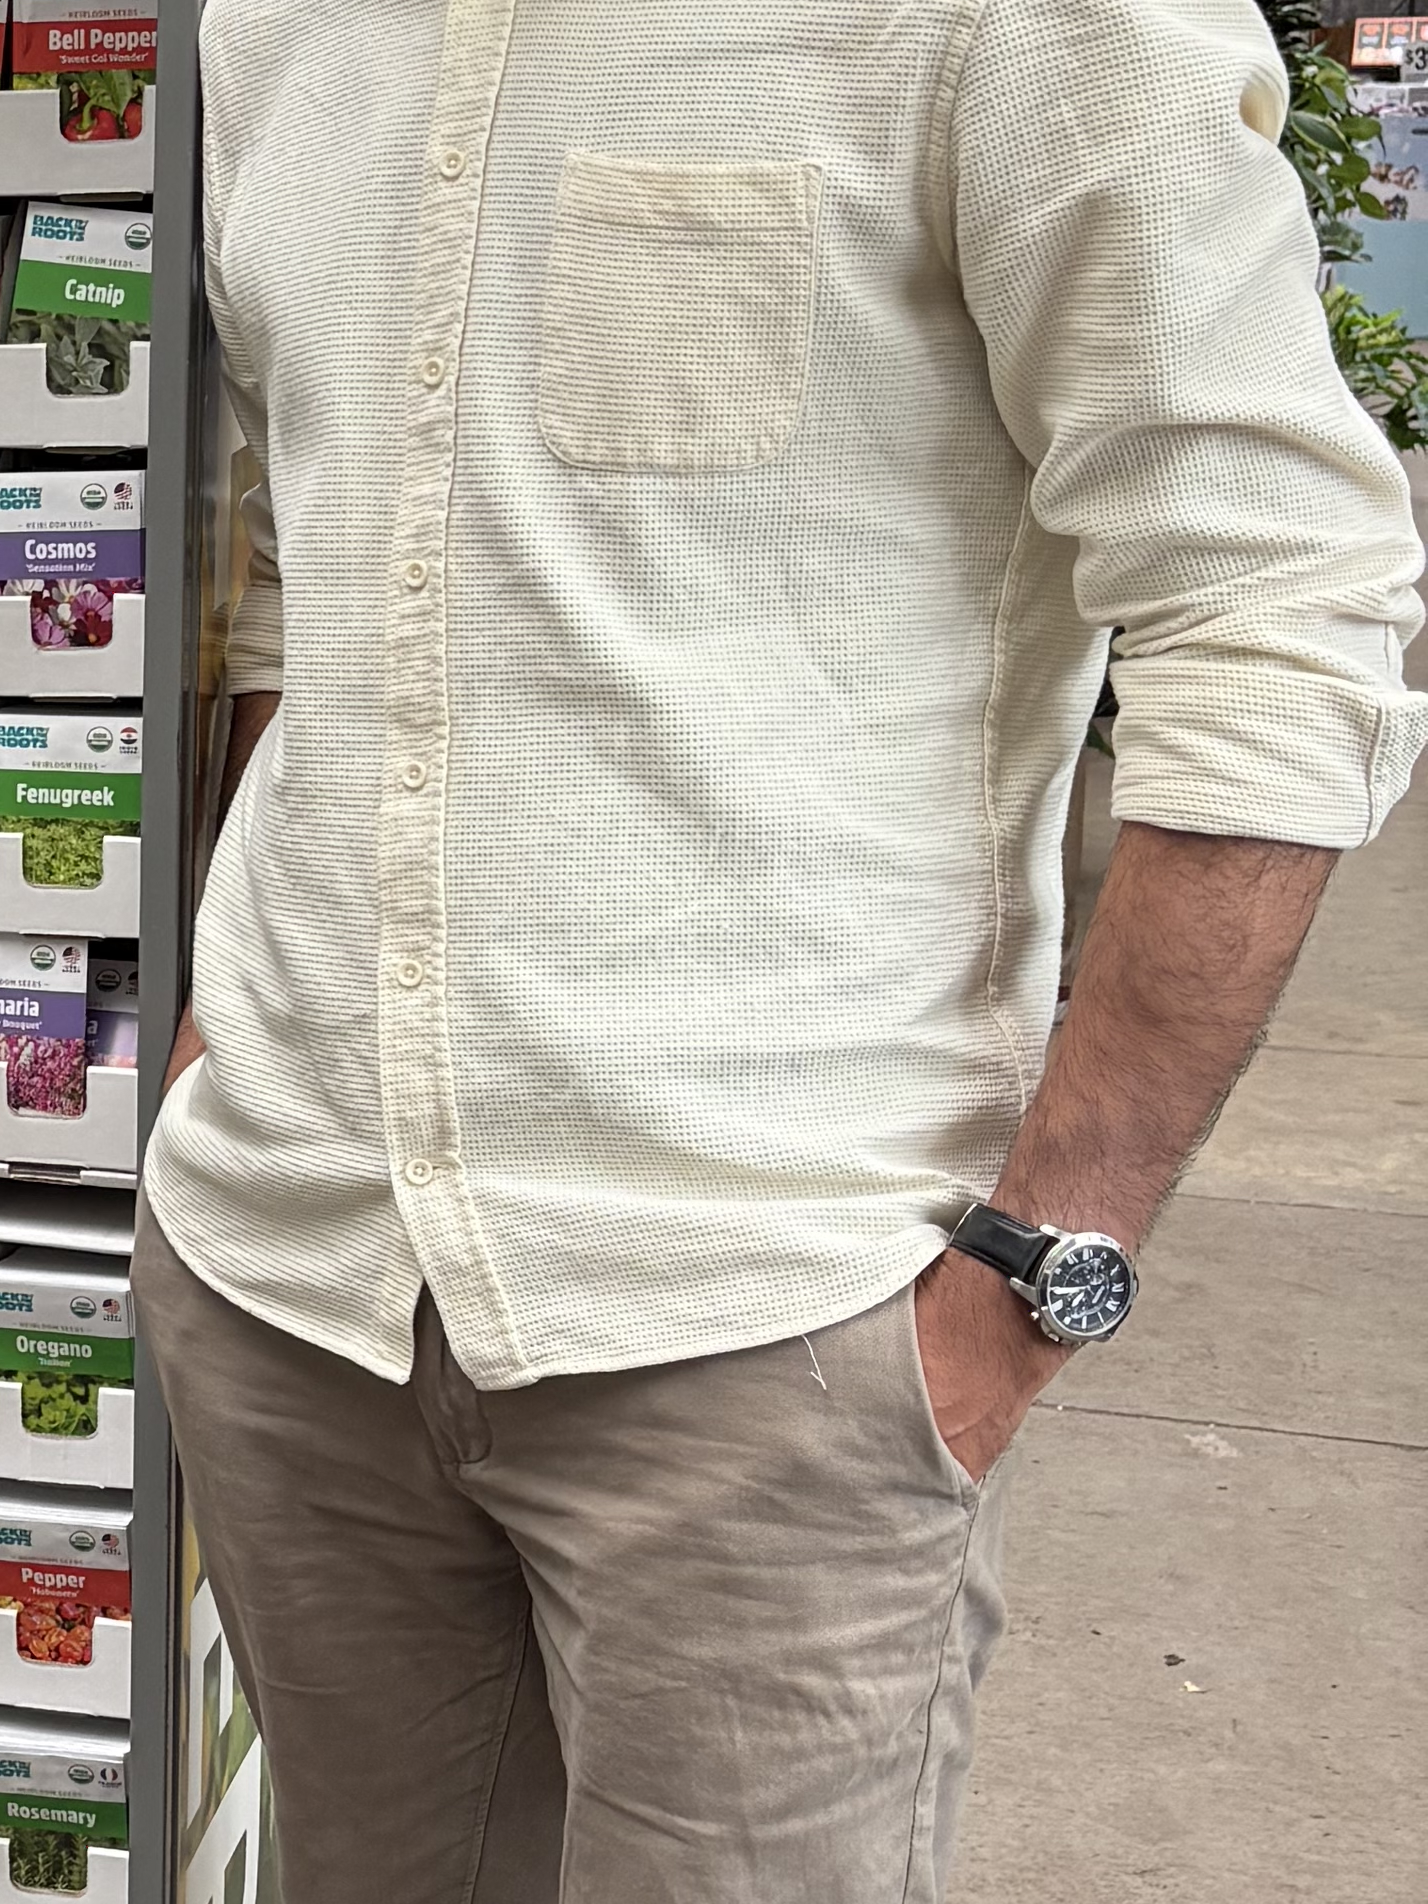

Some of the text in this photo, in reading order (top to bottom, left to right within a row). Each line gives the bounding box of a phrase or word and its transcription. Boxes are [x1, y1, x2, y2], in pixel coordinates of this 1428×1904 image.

[65, 279, 124, 307] Catnip
[25, 540, 96, 559] Cosmos
[17, 784, 114, 807] Fenugreek
[17, 1336, 92, 1357] Oregano
